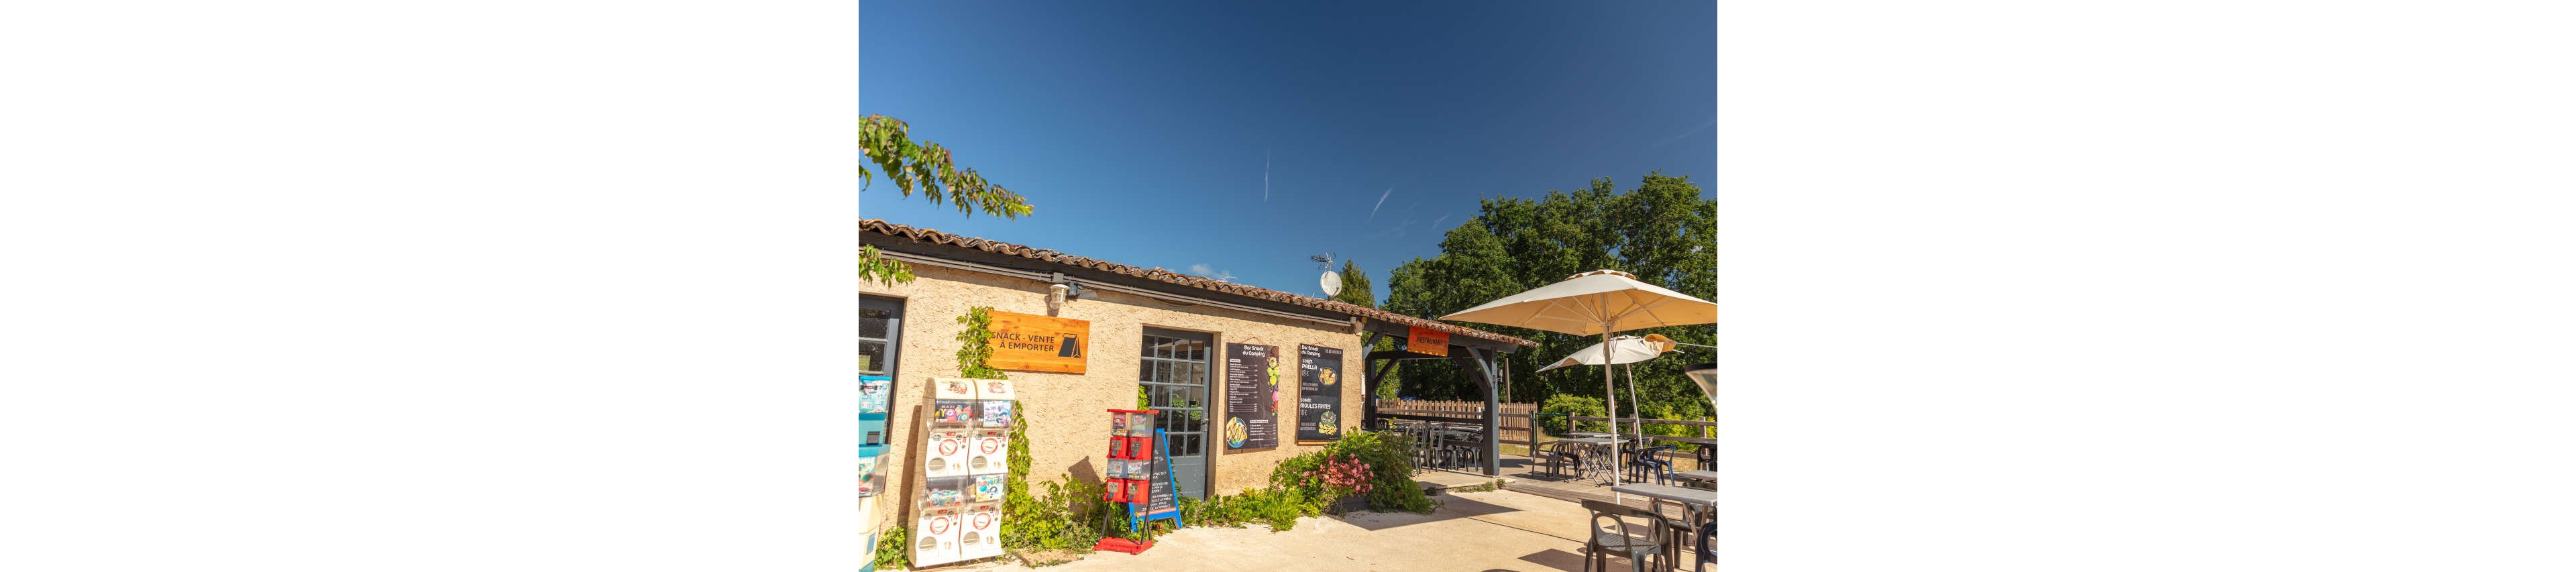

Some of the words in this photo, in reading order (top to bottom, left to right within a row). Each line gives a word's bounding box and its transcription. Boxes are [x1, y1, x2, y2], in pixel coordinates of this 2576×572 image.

[991, 331, 1020, 341] SNACK
[1028, 335, 1055, 344] VENTE
[1417, 337, 1444, 346] RESTAURANT
[999, 341, 1006, 349] À
[1008, 342, 1054, 352] EMPORTER
